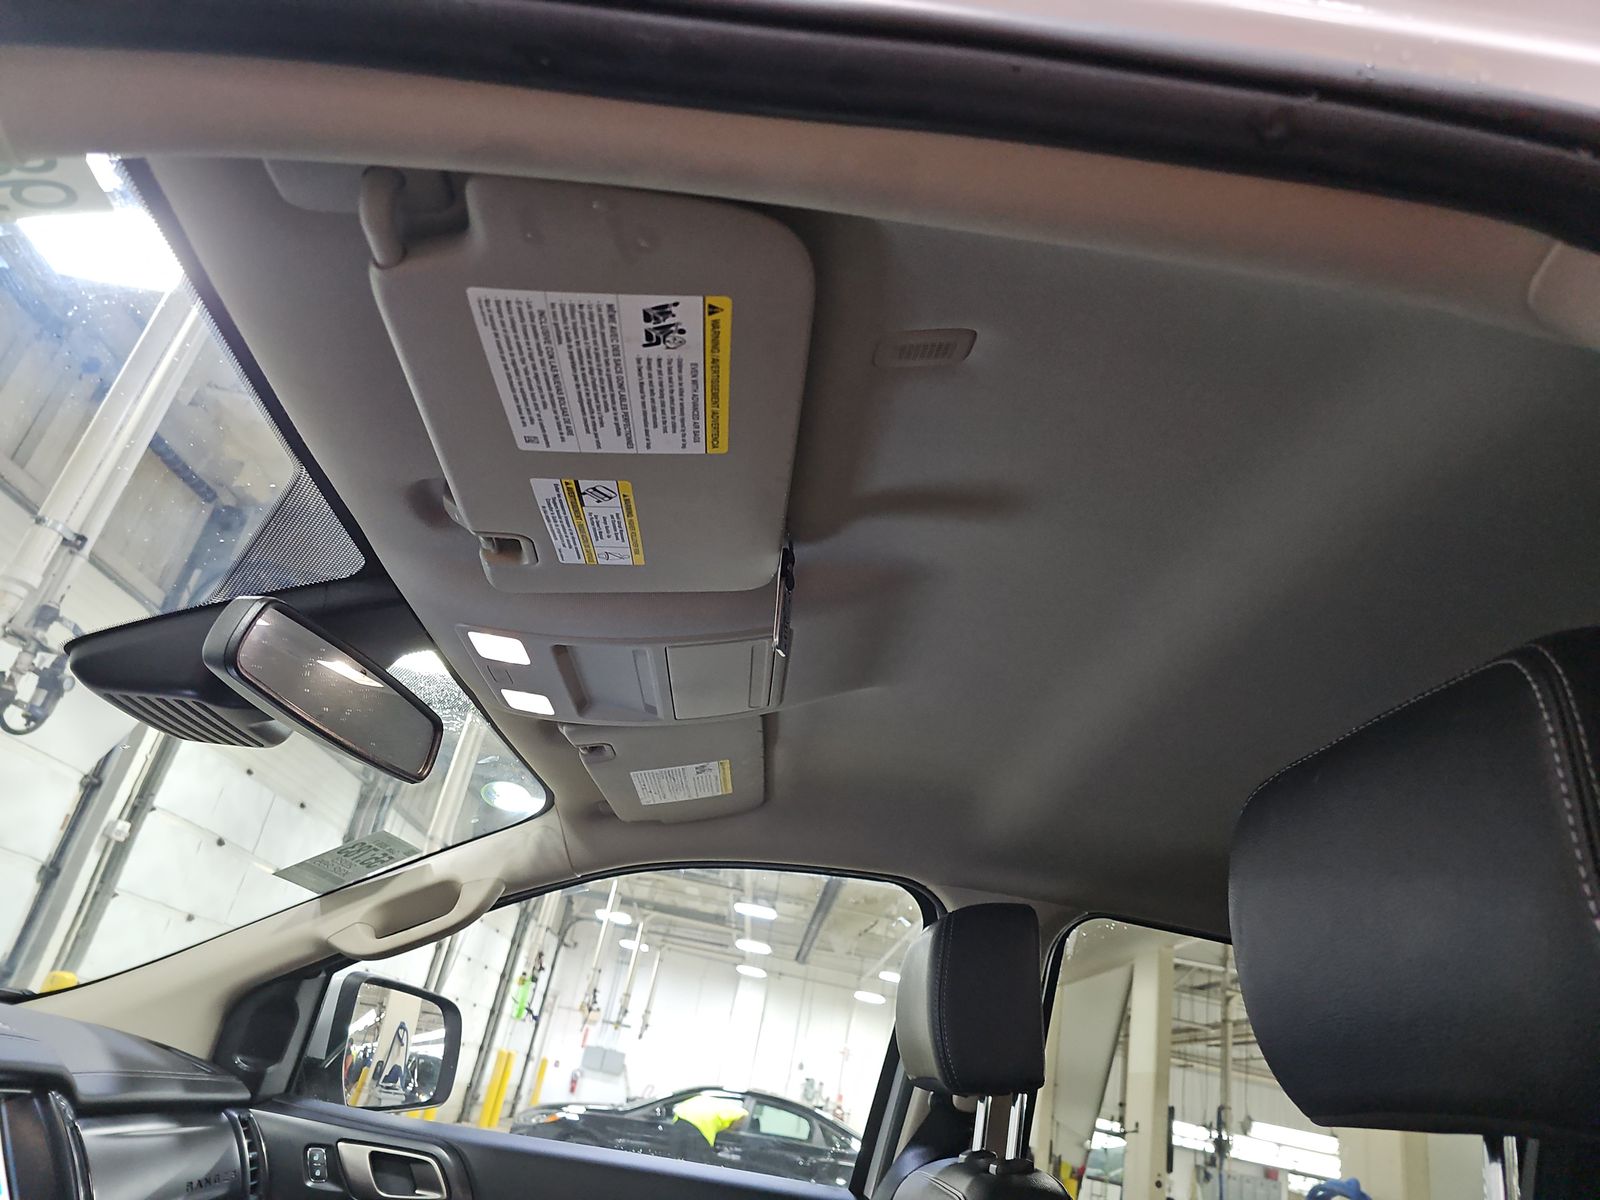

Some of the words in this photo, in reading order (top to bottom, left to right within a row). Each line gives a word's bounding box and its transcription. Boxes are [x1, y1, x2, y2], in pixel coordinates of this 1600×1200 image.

[536, 309, 553, 344] INCLUSIVE
[608, 326, 619, 342] AVEC
[710, 319, 720, 353] WARNING
[545, 346, 556, 359] CON
[610, 344, 621, 356] DES
[548, 361, 559, 372] LAS
[613, 358, 623, 374] SACS
[690, 362, 698, 377] EVEN
[551, 373, 564, 394] NUEVAS
[690, 379, 699, 392] WITH
[710, 357, 720, 408] AVERTISSEMENT
[615, 375, 628, 410] GONFLABLES
[557, 396, 569, 416] BOLSAS
[691, 394, 699, 420] ADVANCED
[564, 425, 573, 436] AIRE
[692, 430, 700, 442] BAGS
